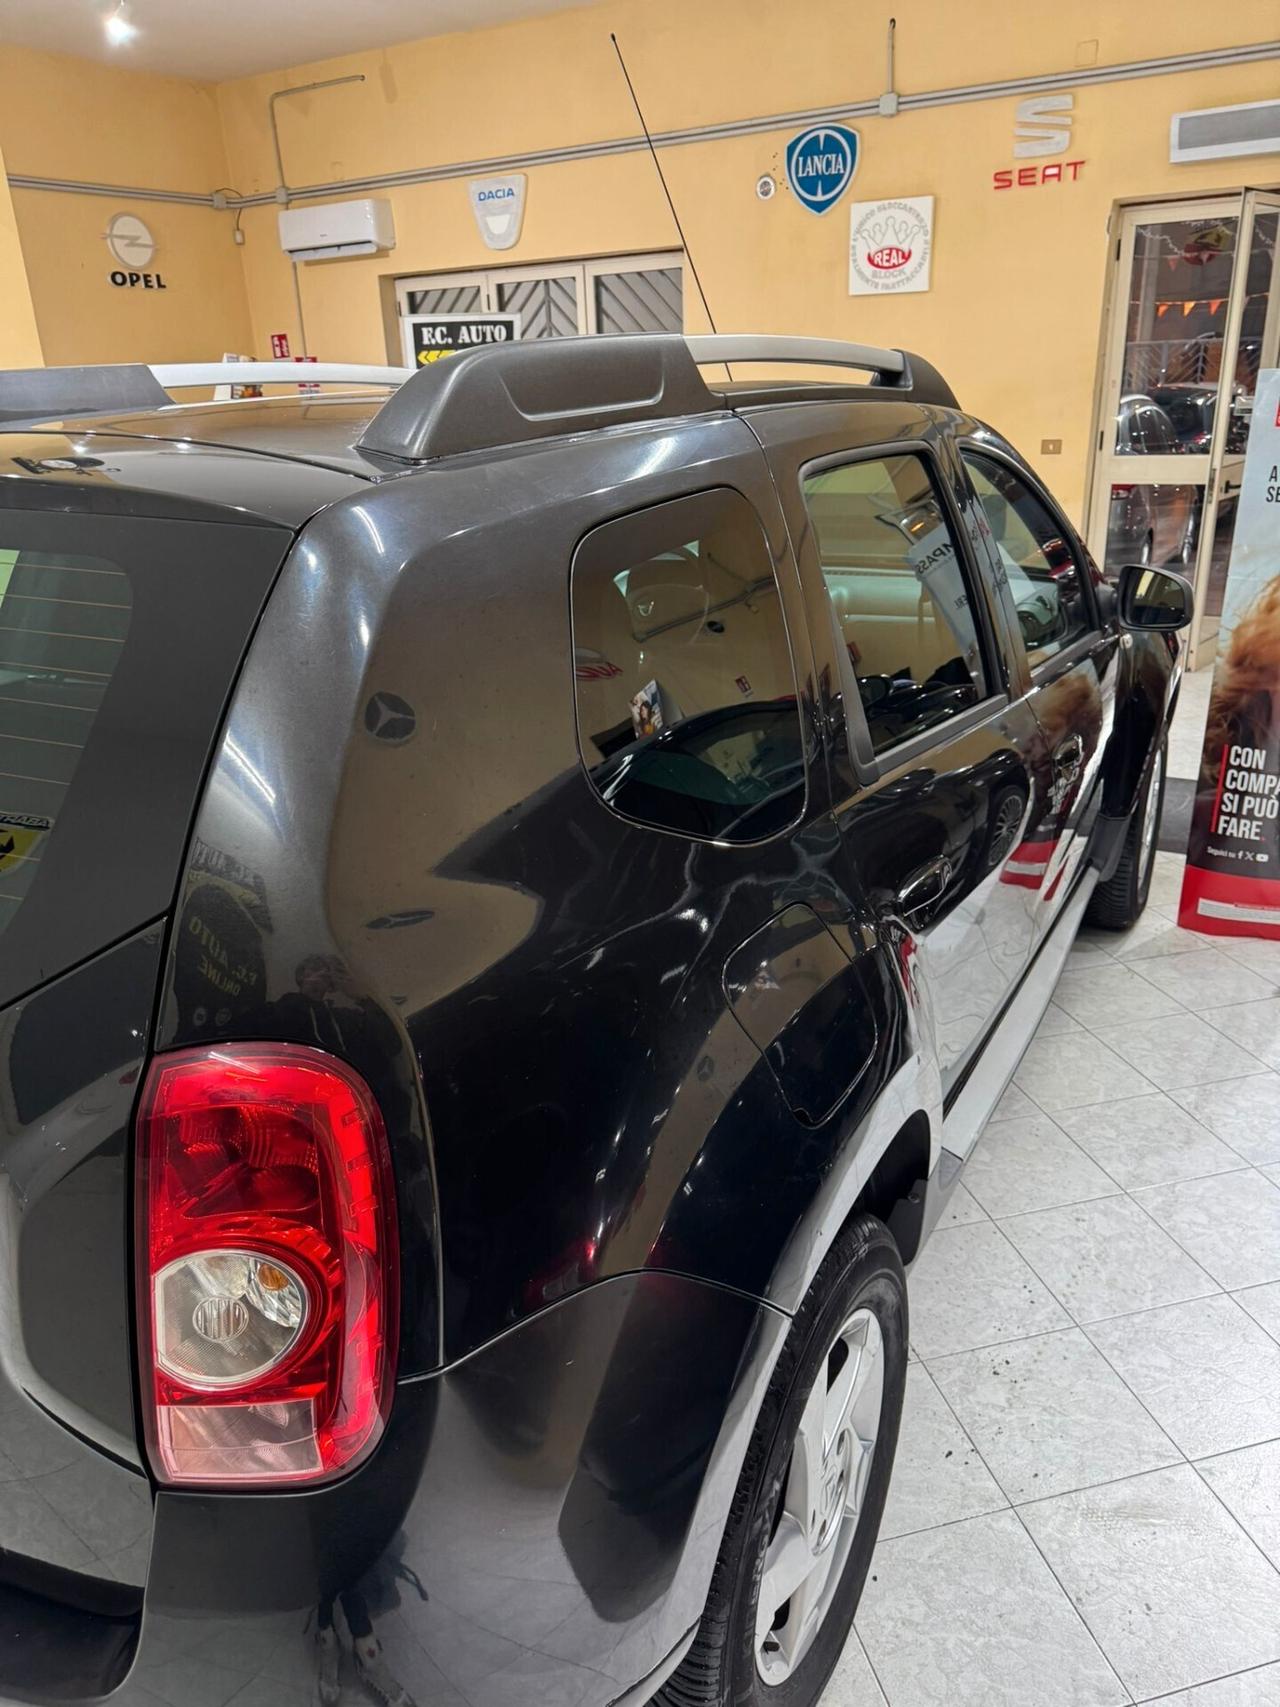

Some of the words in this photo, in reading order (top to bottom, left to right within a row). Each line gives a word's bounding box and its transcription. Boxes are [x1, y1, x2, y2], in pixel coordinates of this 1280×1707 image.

[798, 153, 844, 177] LANCIA
[993, 161, 1085, 189] SEAT
[478, 188, 514, 201] DACIA
[874, 249, 906, 267] REAL
[110, 271, 166, 288] OPEL
[421, 326, 453, 345] F.C.
[458, 325, 507, 343] AUTO
[1269, 465, 1278, 482] A
[1229, 745, 1266, 770] CON
[1221, 792, 1240, 814] SI
[1242, 795, 1279, 819] PUÒ
